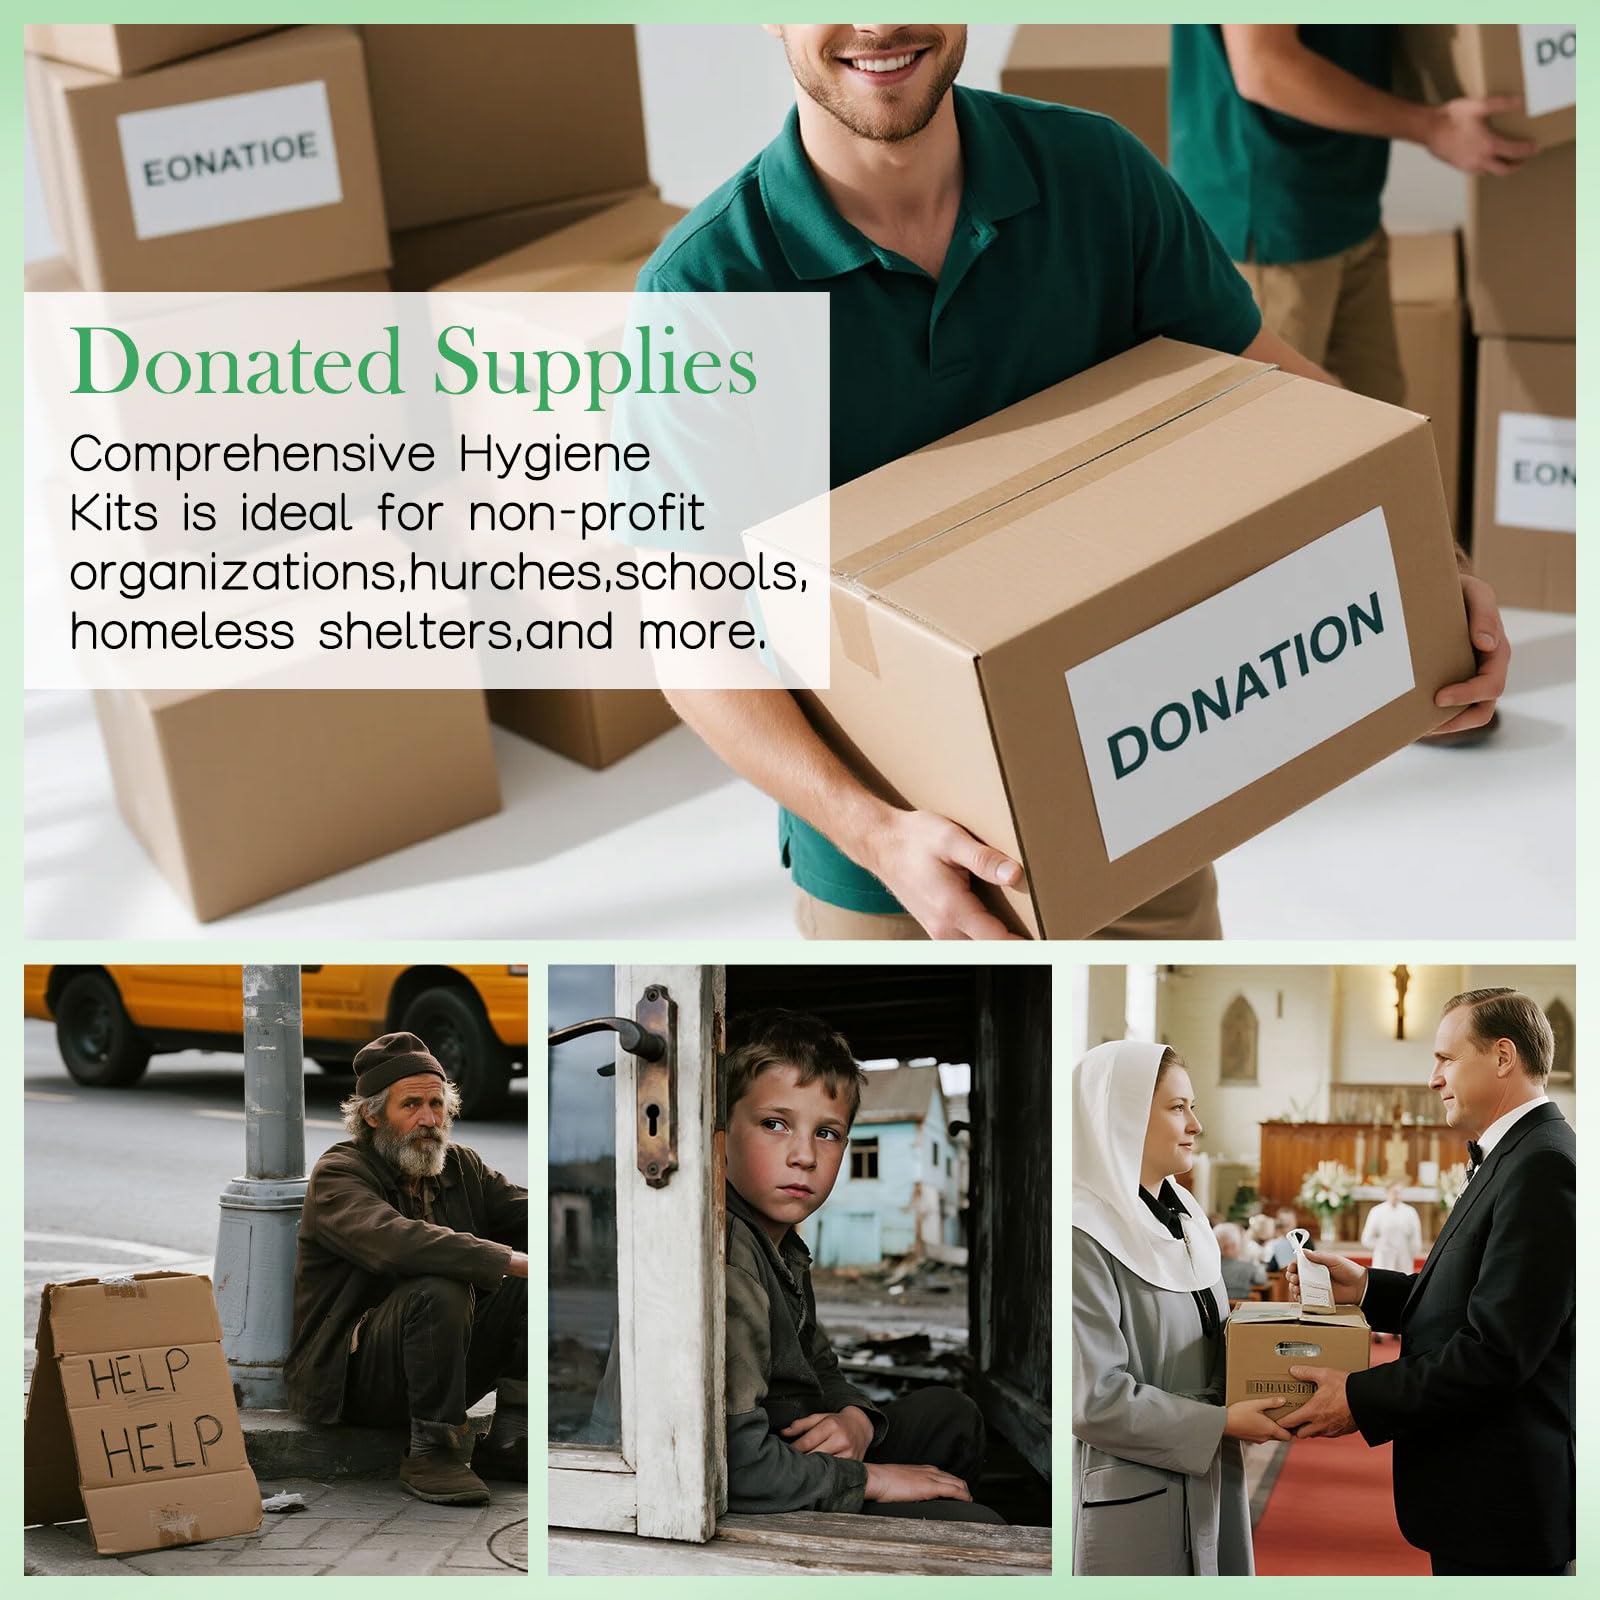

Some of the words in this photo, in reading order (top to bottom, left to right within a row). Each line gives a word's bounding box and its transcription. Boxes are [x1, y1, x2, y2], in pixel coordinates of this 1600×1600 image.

[142, 130, 318, 187] EONATIOE
[1107, 591, 1385, 781] DONATION
[88, 1347, 190, 1400] HELP
[100, 1414, 223, 1478] HELP
